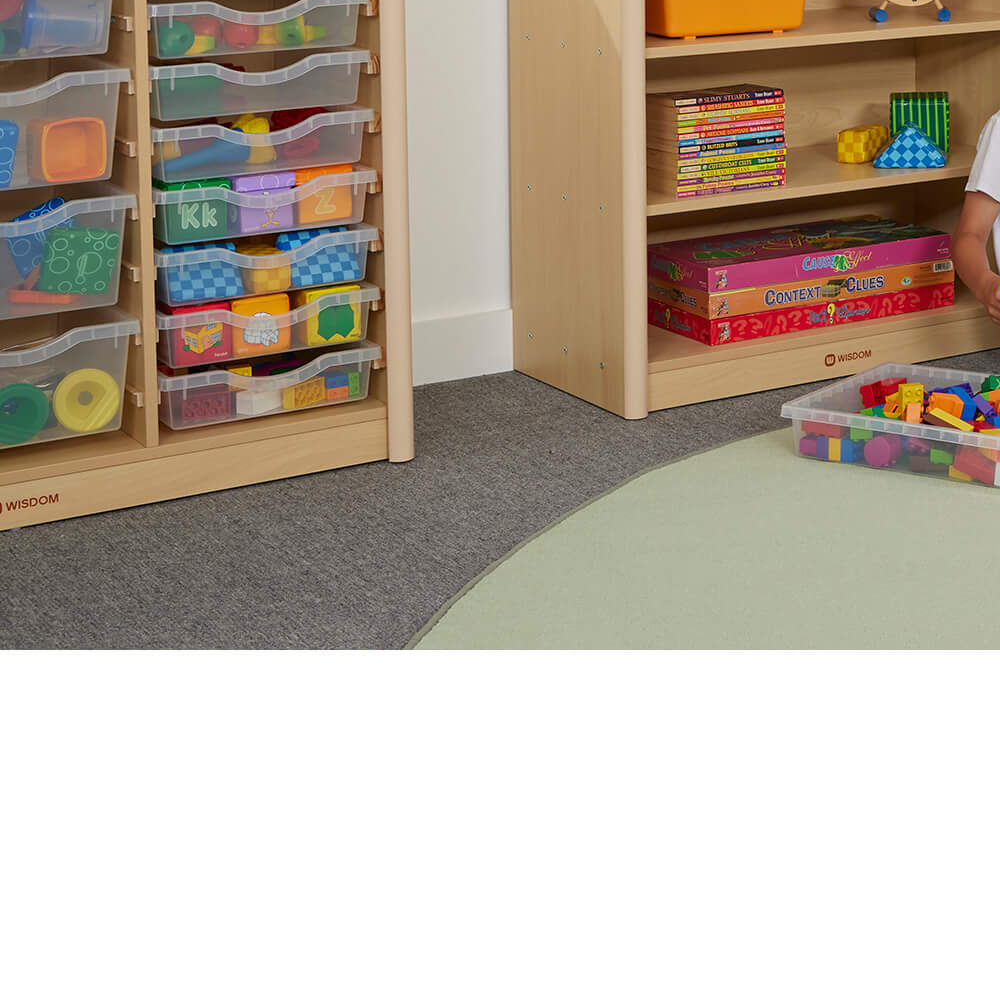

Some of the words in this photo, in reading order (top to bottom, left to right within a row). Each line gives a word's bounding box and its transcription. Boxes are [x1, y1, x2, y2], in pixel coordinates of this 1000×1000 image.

[764, 286, 821, 306] CONTEXT
[846, 276, 884, 293] CLUES
[837, 349, 872, 362] WISDOM
[5, 493, 59, 511] WISDOM
